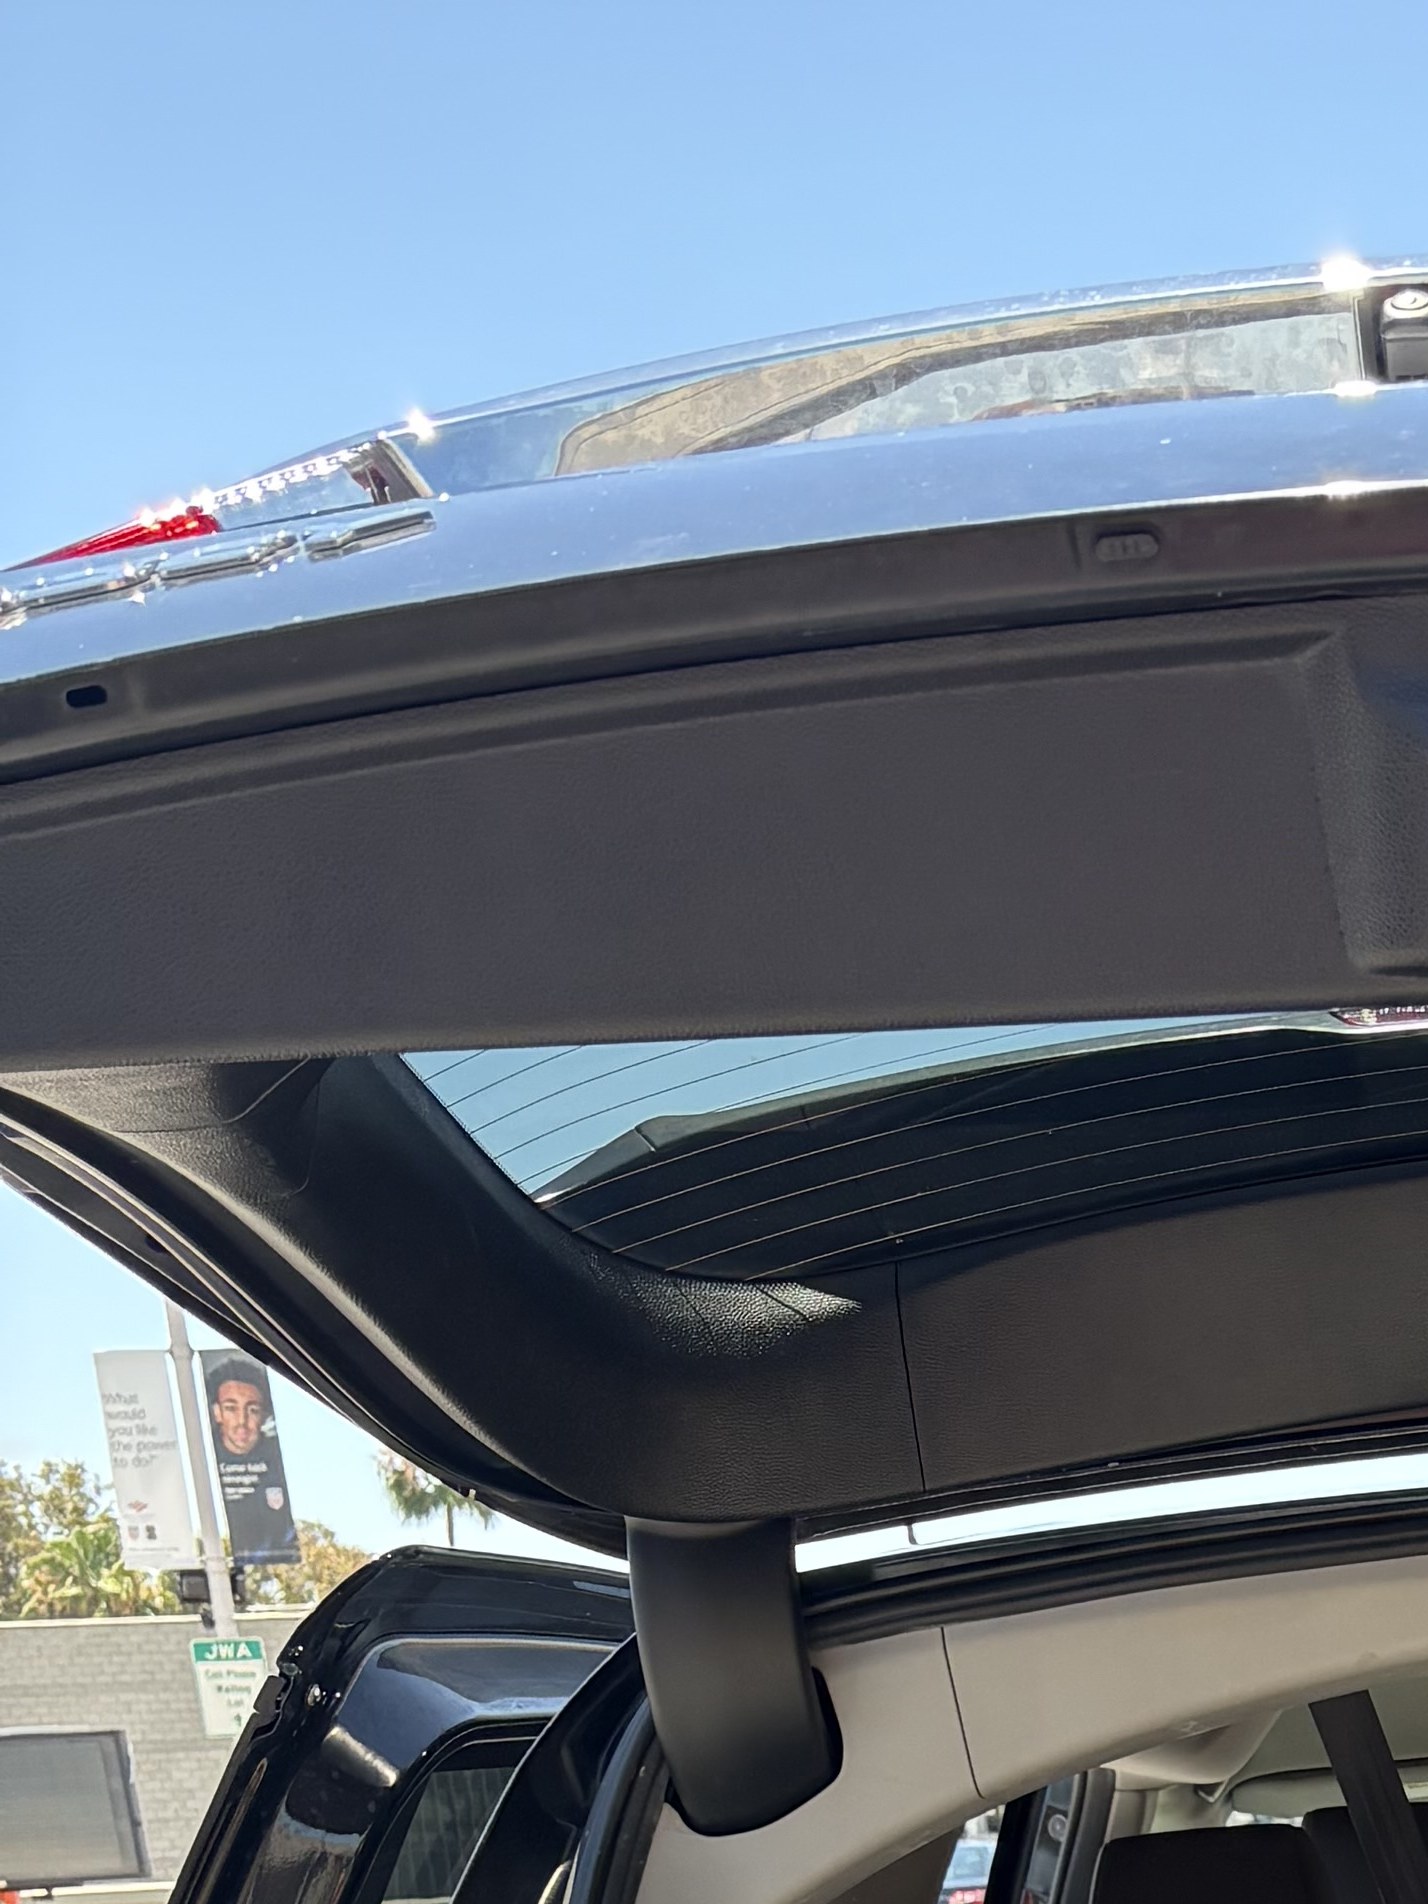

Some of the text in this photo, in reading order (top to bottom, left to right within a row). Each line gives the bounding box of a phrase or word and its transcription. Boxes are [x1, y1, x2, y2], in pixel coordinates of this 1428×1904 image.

[108, 1425, 132, 1439] you
[110, 1440, 132, 1452] the
[204, 1642, 252, 1660] JWA
